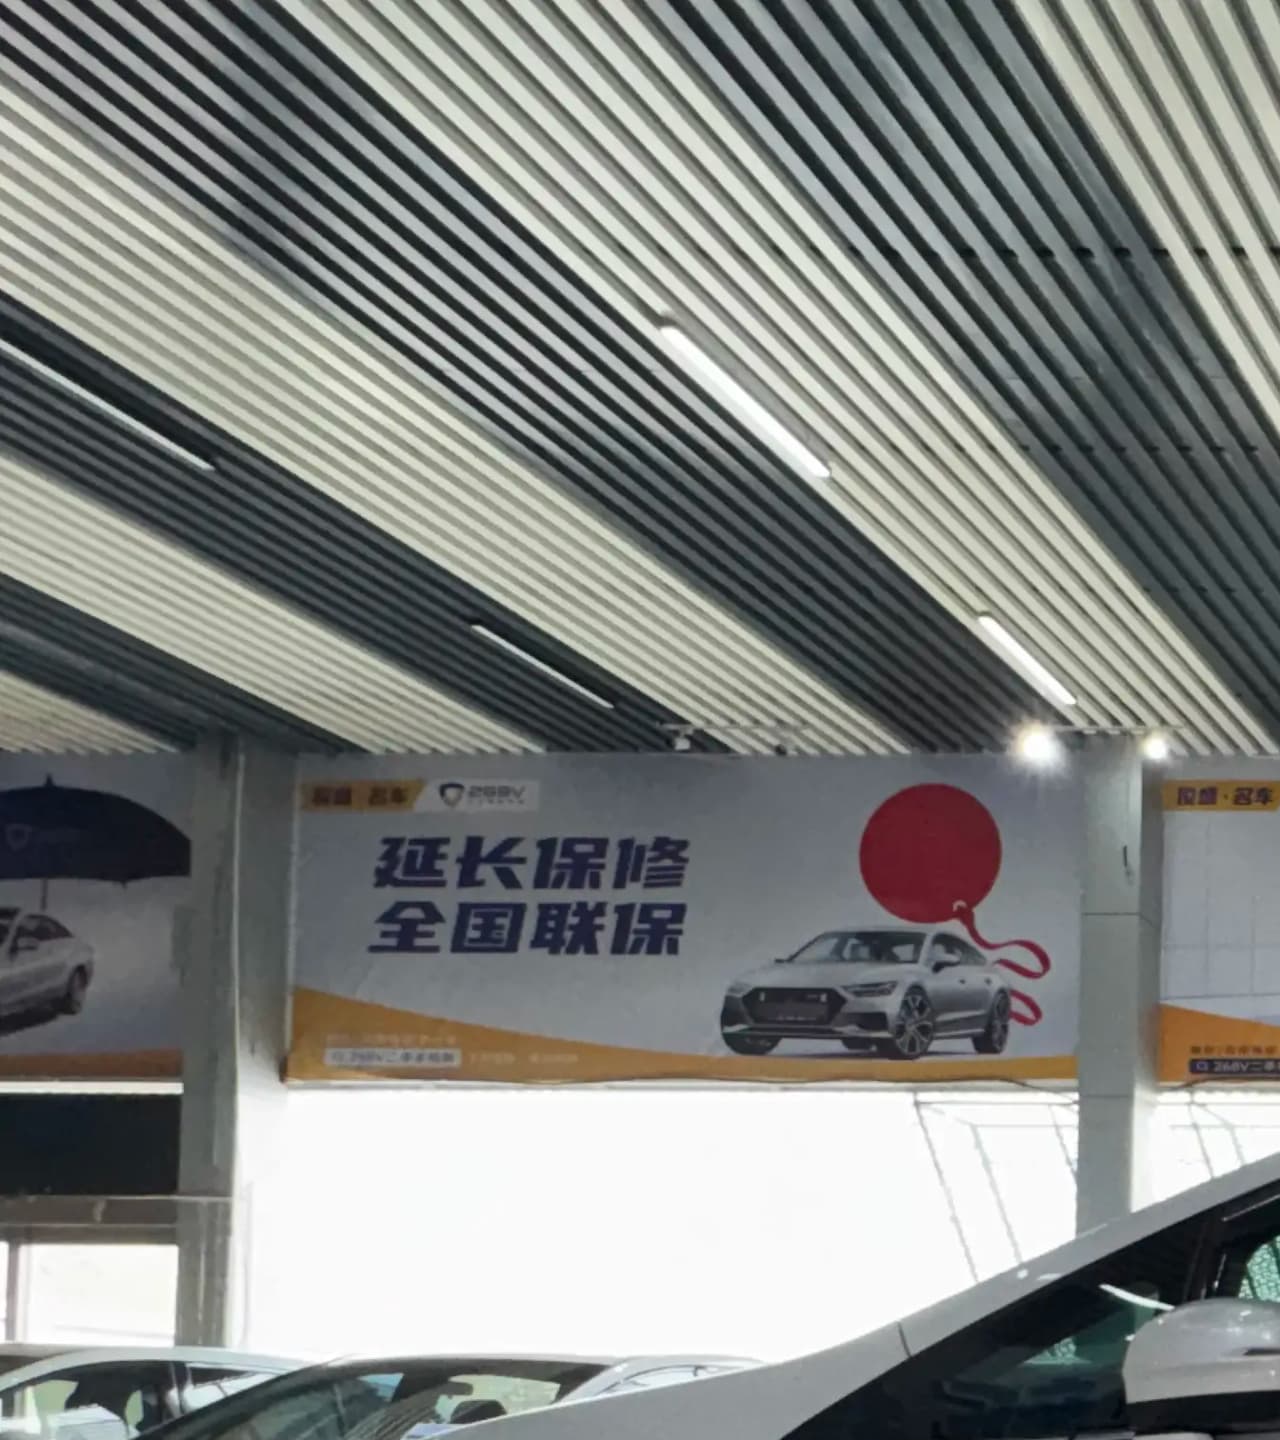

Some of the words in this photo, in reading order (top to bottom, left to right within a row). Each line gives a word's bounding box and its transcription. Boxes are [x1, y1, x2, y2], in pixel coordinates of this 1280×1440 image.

[373, 836, 690, 890] 延长保修
[368, 900, 688, 955] 全国联保
